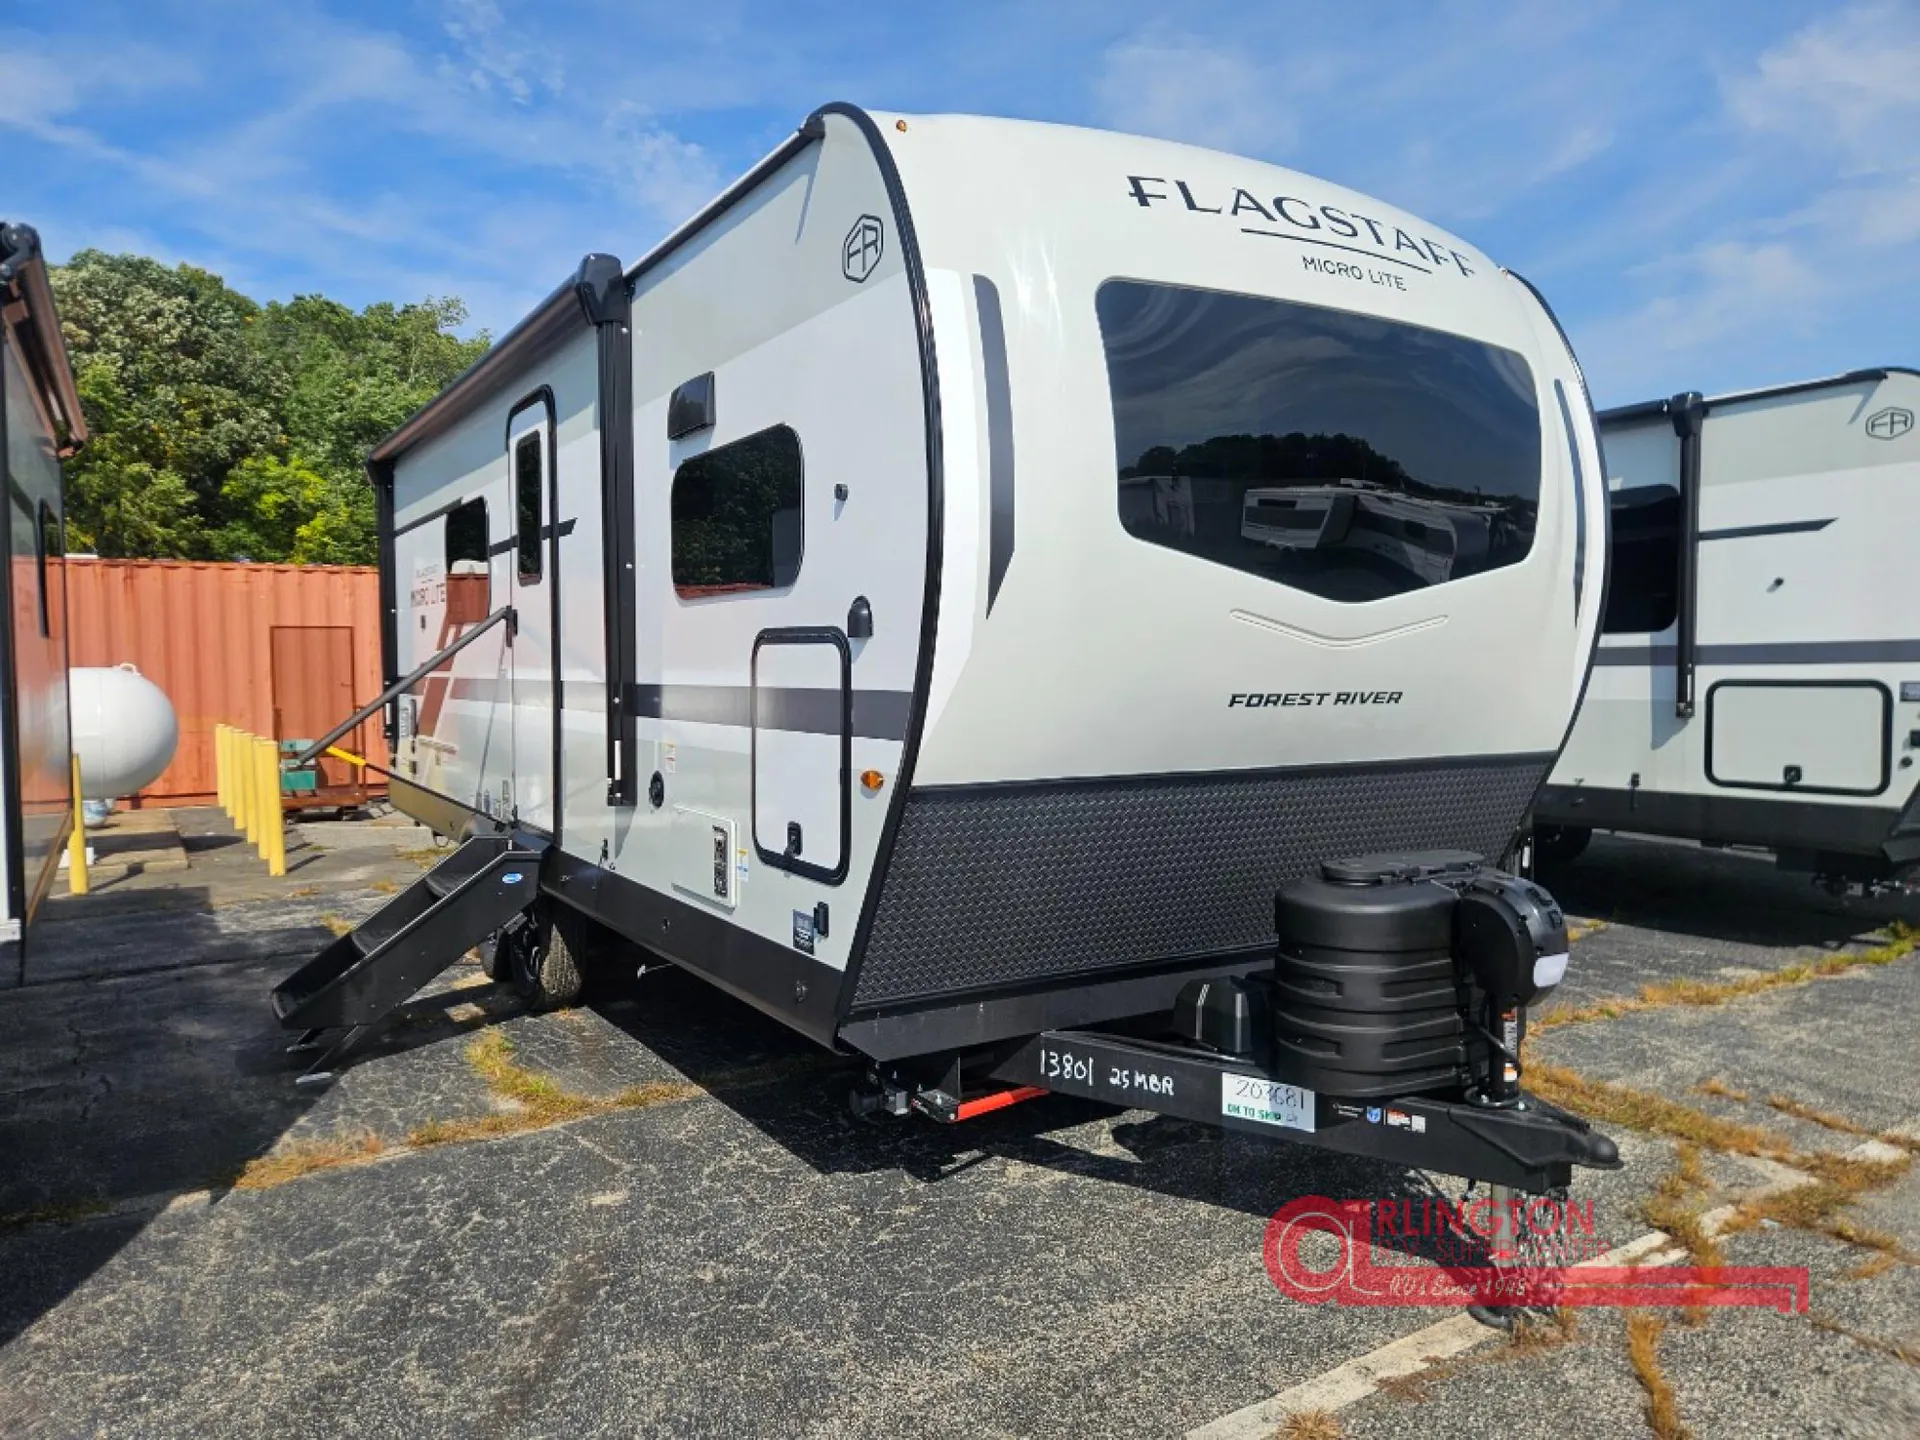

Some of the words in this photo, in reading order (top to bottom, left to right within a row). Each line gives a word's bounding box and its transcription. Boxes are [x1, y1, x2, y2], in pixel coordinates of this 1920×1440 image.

[1126, 175, 1475, 278] FLAGSTAFF
[1301, 255, 1364, 281] MICRO
[1368, 269, 1407, 292] LITE
[1228, 692, 1331, 708] FOREST
[1333, 691, 1403, 706] RIVER
[1040, 1049, 1094, 1087] 13801
